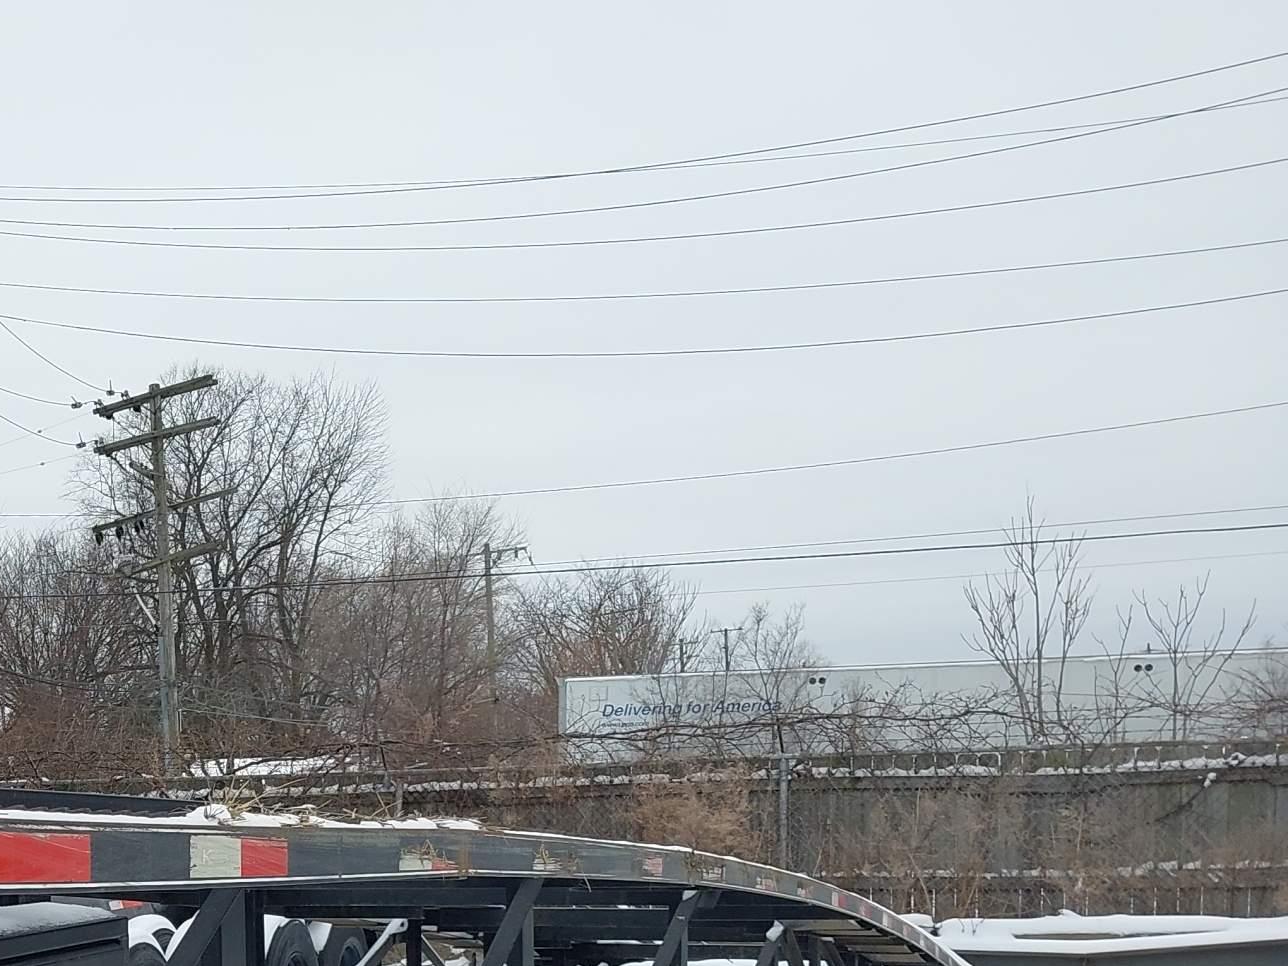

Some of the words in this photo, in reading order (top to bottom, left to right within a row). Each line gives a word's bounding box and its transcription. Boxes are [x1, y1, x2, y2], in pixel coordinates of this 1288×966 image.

[603, 703, 682, 719] Delivering
[686, 700, 709, 716] for
[713, 700, 781, 714] America
